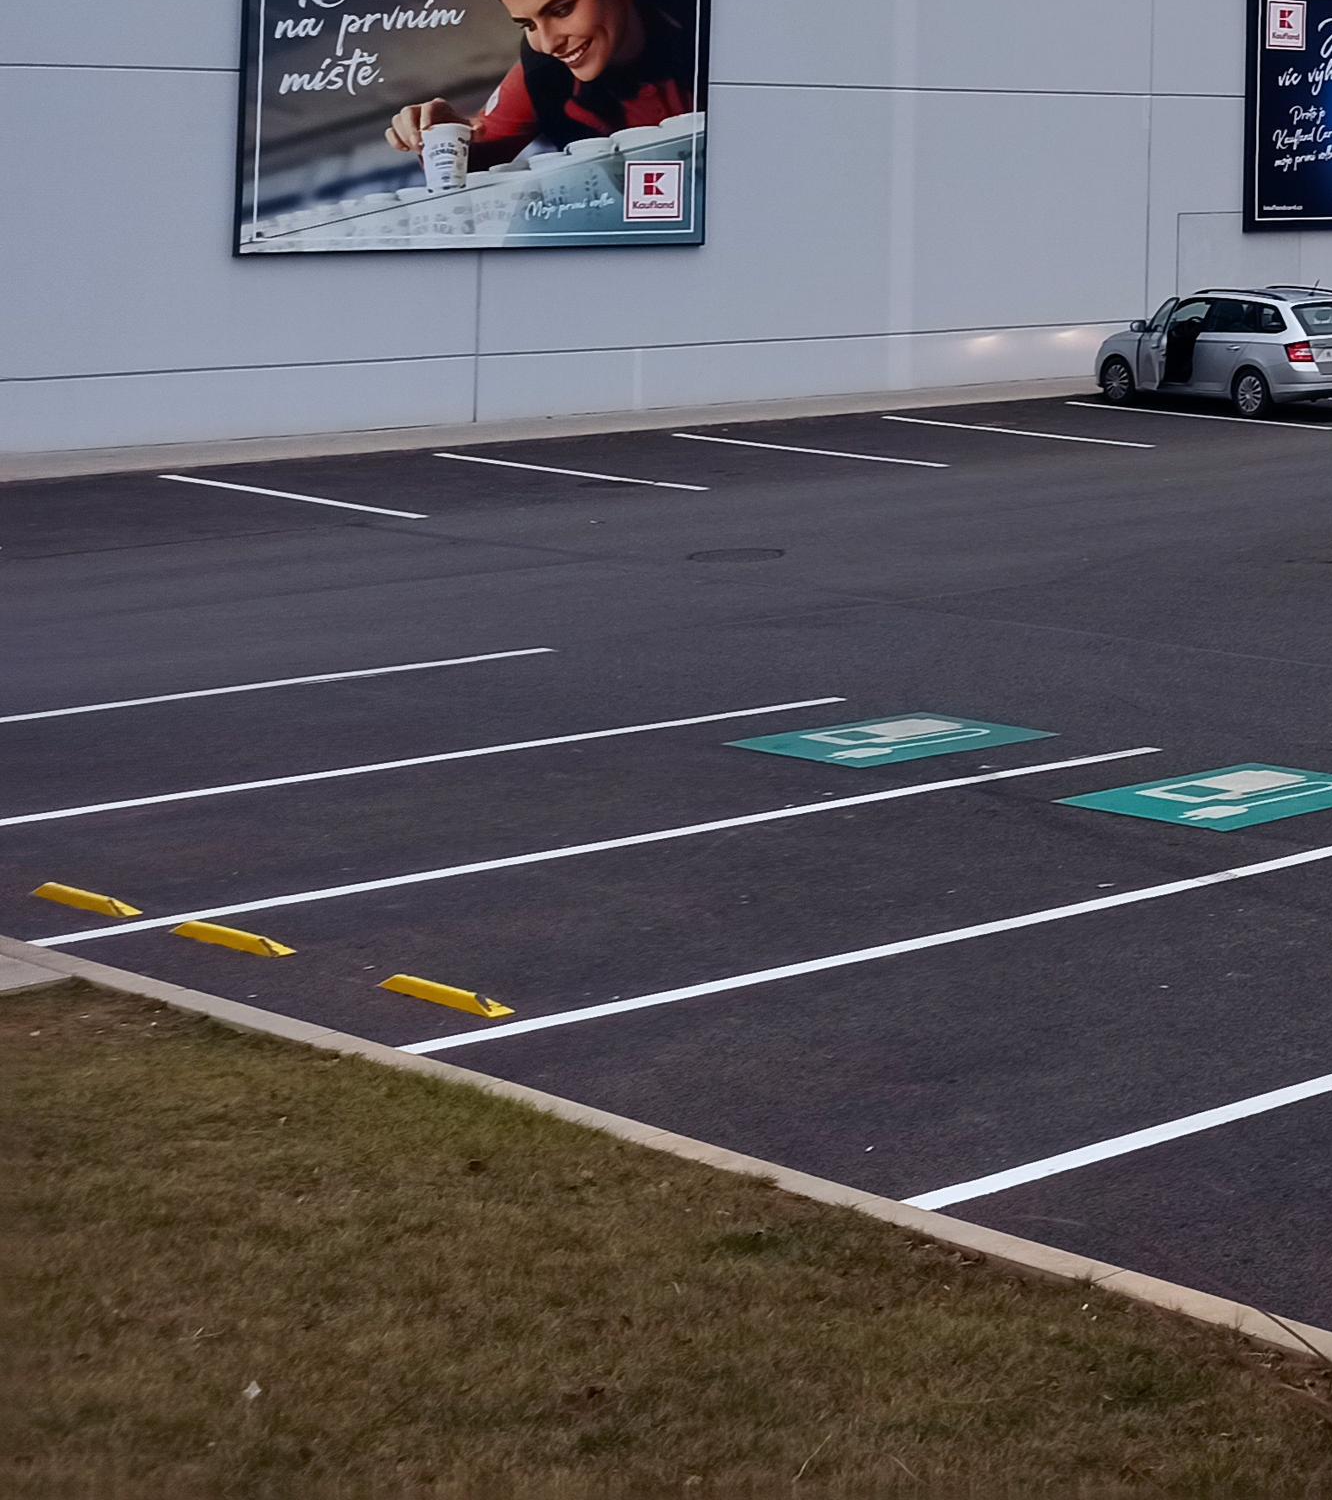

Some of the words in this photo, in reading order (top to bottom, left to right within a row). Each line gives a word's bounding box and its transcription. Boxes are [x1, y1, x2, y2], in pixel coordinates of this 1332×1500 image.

[274, 17, 325, 39] na
[278, 48, 385, 95] místě.
[1278, 67, 1302, 86] víc
[632, 200, 675, 209] Kaufland
